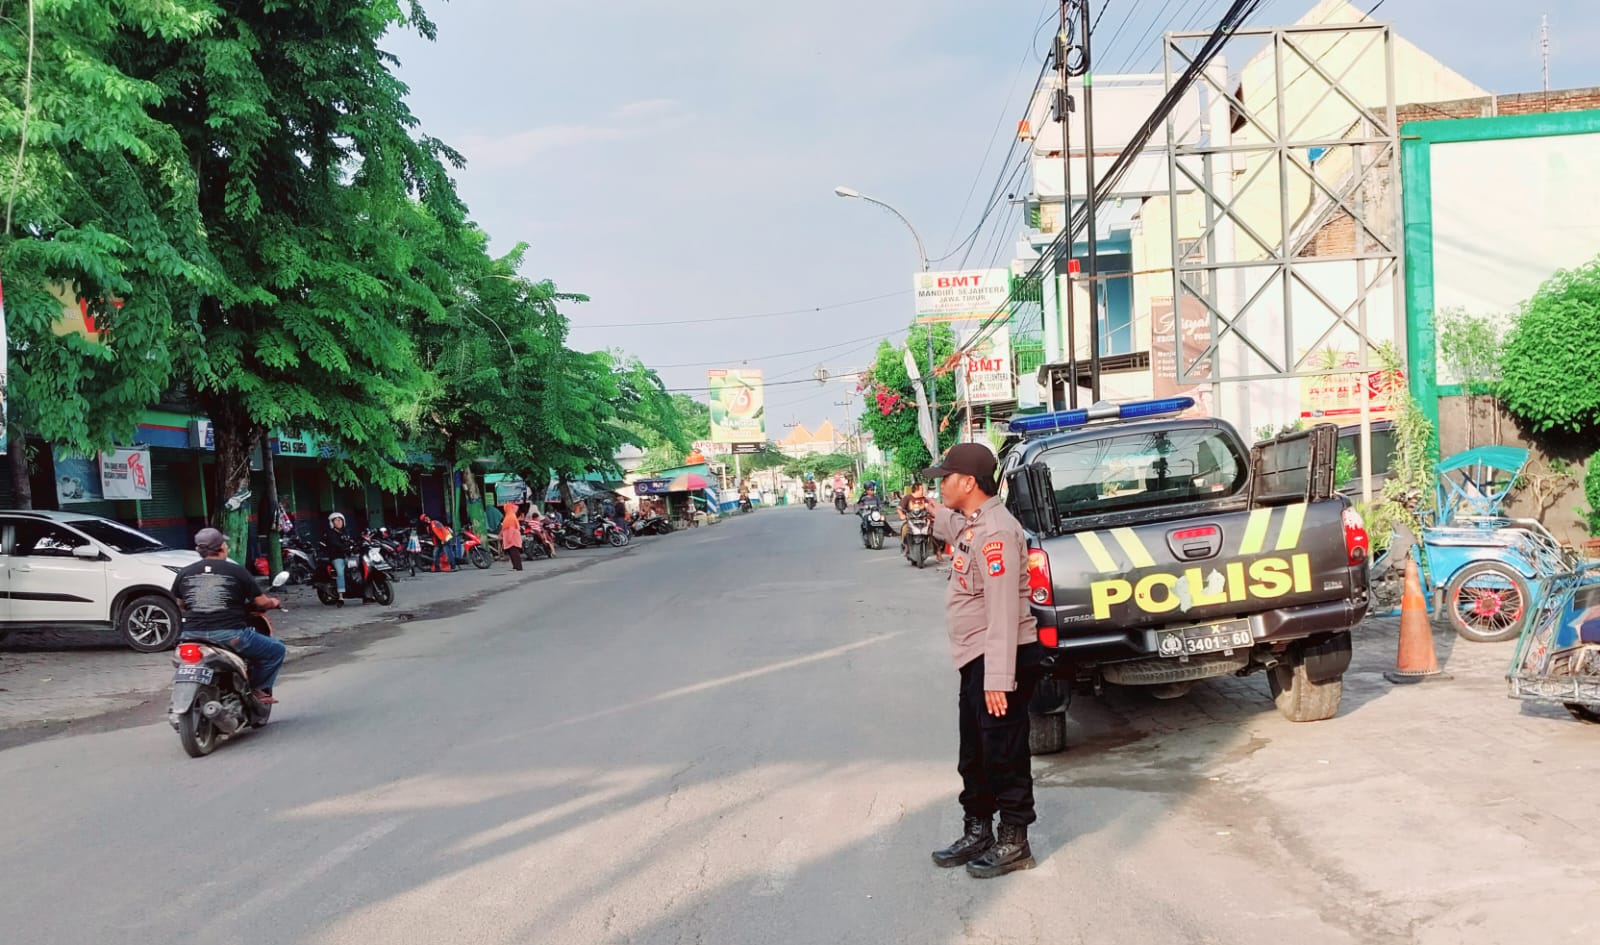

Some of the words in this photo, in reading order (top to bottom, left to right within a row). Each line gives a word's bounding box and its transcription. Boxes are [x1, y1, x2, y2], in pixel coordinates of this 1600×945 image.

[937, 275, 982, 288] BMT
[918, 288, 954, 297] MANDIRI
[958, 286, 1005, 296] SEJAHTERA
[968, 358, 1003, 372] BMT
[1090, 553, 1312, 620] POLISI
